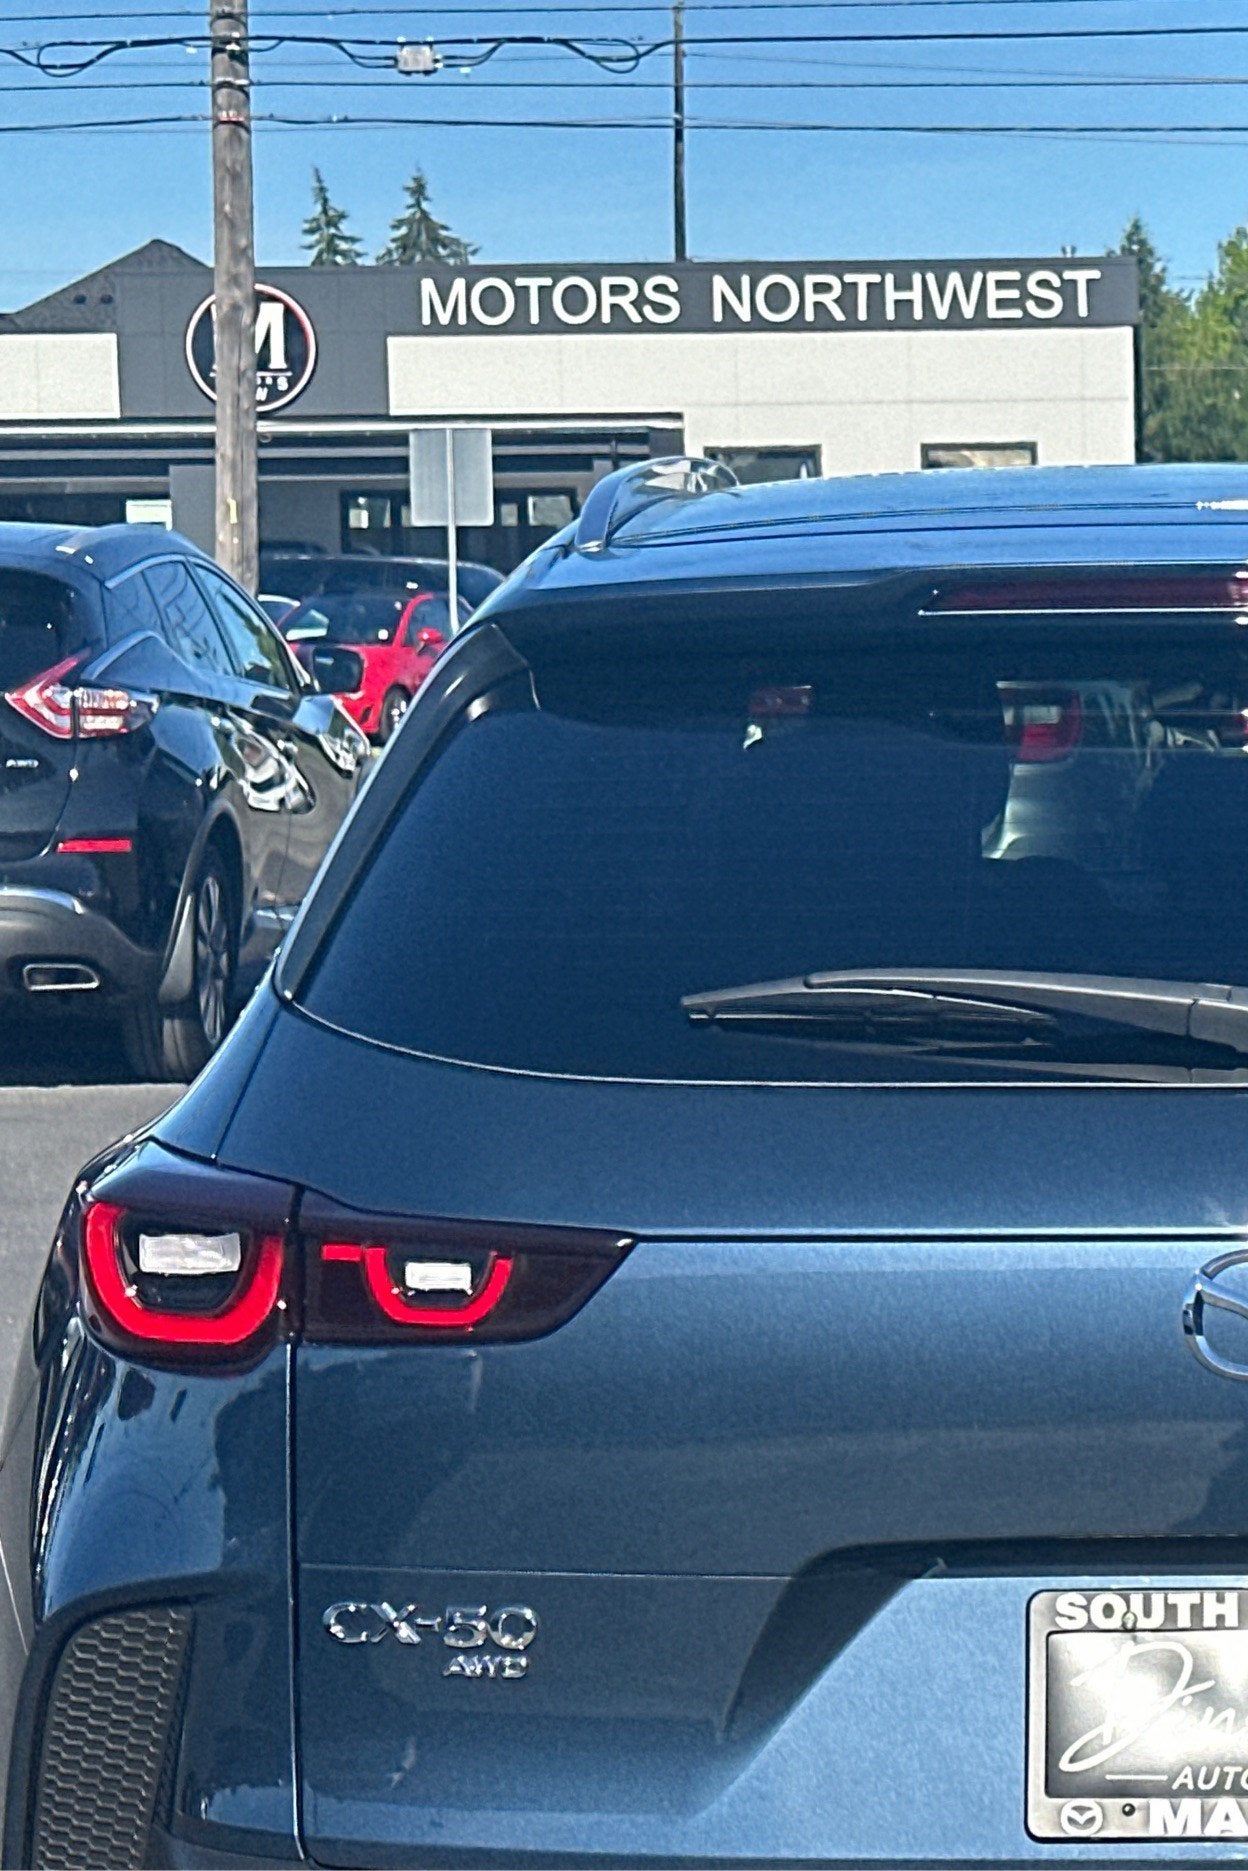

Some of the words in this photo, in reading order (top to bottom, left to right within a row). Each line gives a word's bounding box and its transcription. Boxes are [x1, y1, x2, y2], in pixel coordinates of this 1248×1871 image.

[420, 276, 680, 326] MOTORS
[711, 269, 1101, 322] NORTHWEST
[322, 1601, 540, 1650] CX-50
[1055, 1592, 1238, 1629] SOUTH
